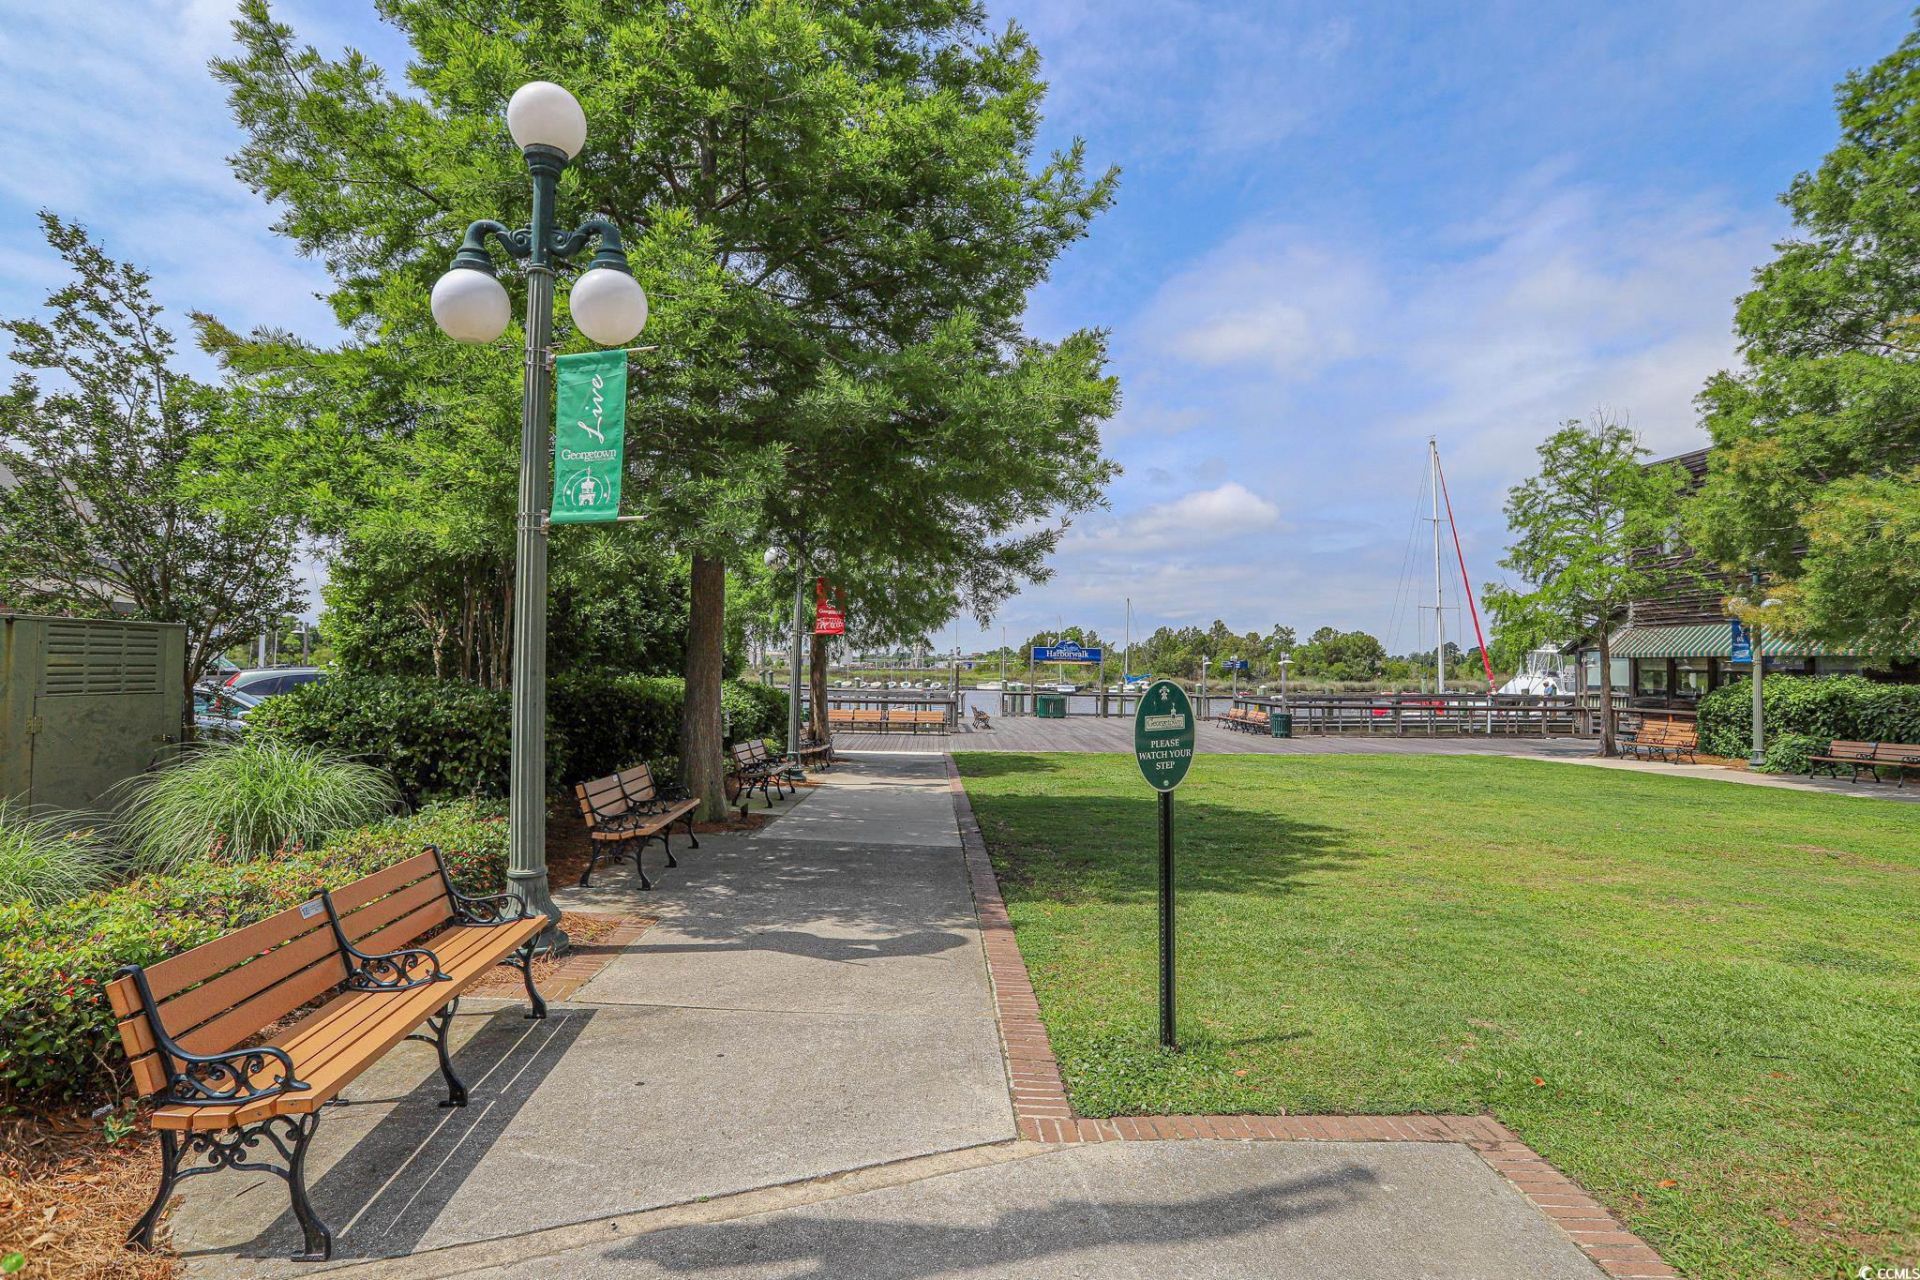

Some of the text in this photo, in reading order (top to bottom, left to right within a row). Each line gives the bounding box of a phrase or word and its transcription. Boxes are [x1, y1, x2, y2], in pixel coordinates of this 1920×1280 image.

[576, 373, 604, 444] Live
[561, 449, 617, 462] Georgetown
[1046, 649, 1088, 658] Harborwalk
[1150, 739, 1180, 748] PLEASE
[1139, 748, 1192, 760] WATCH YOUR
[1156, 761, 1176, 770] STEP
